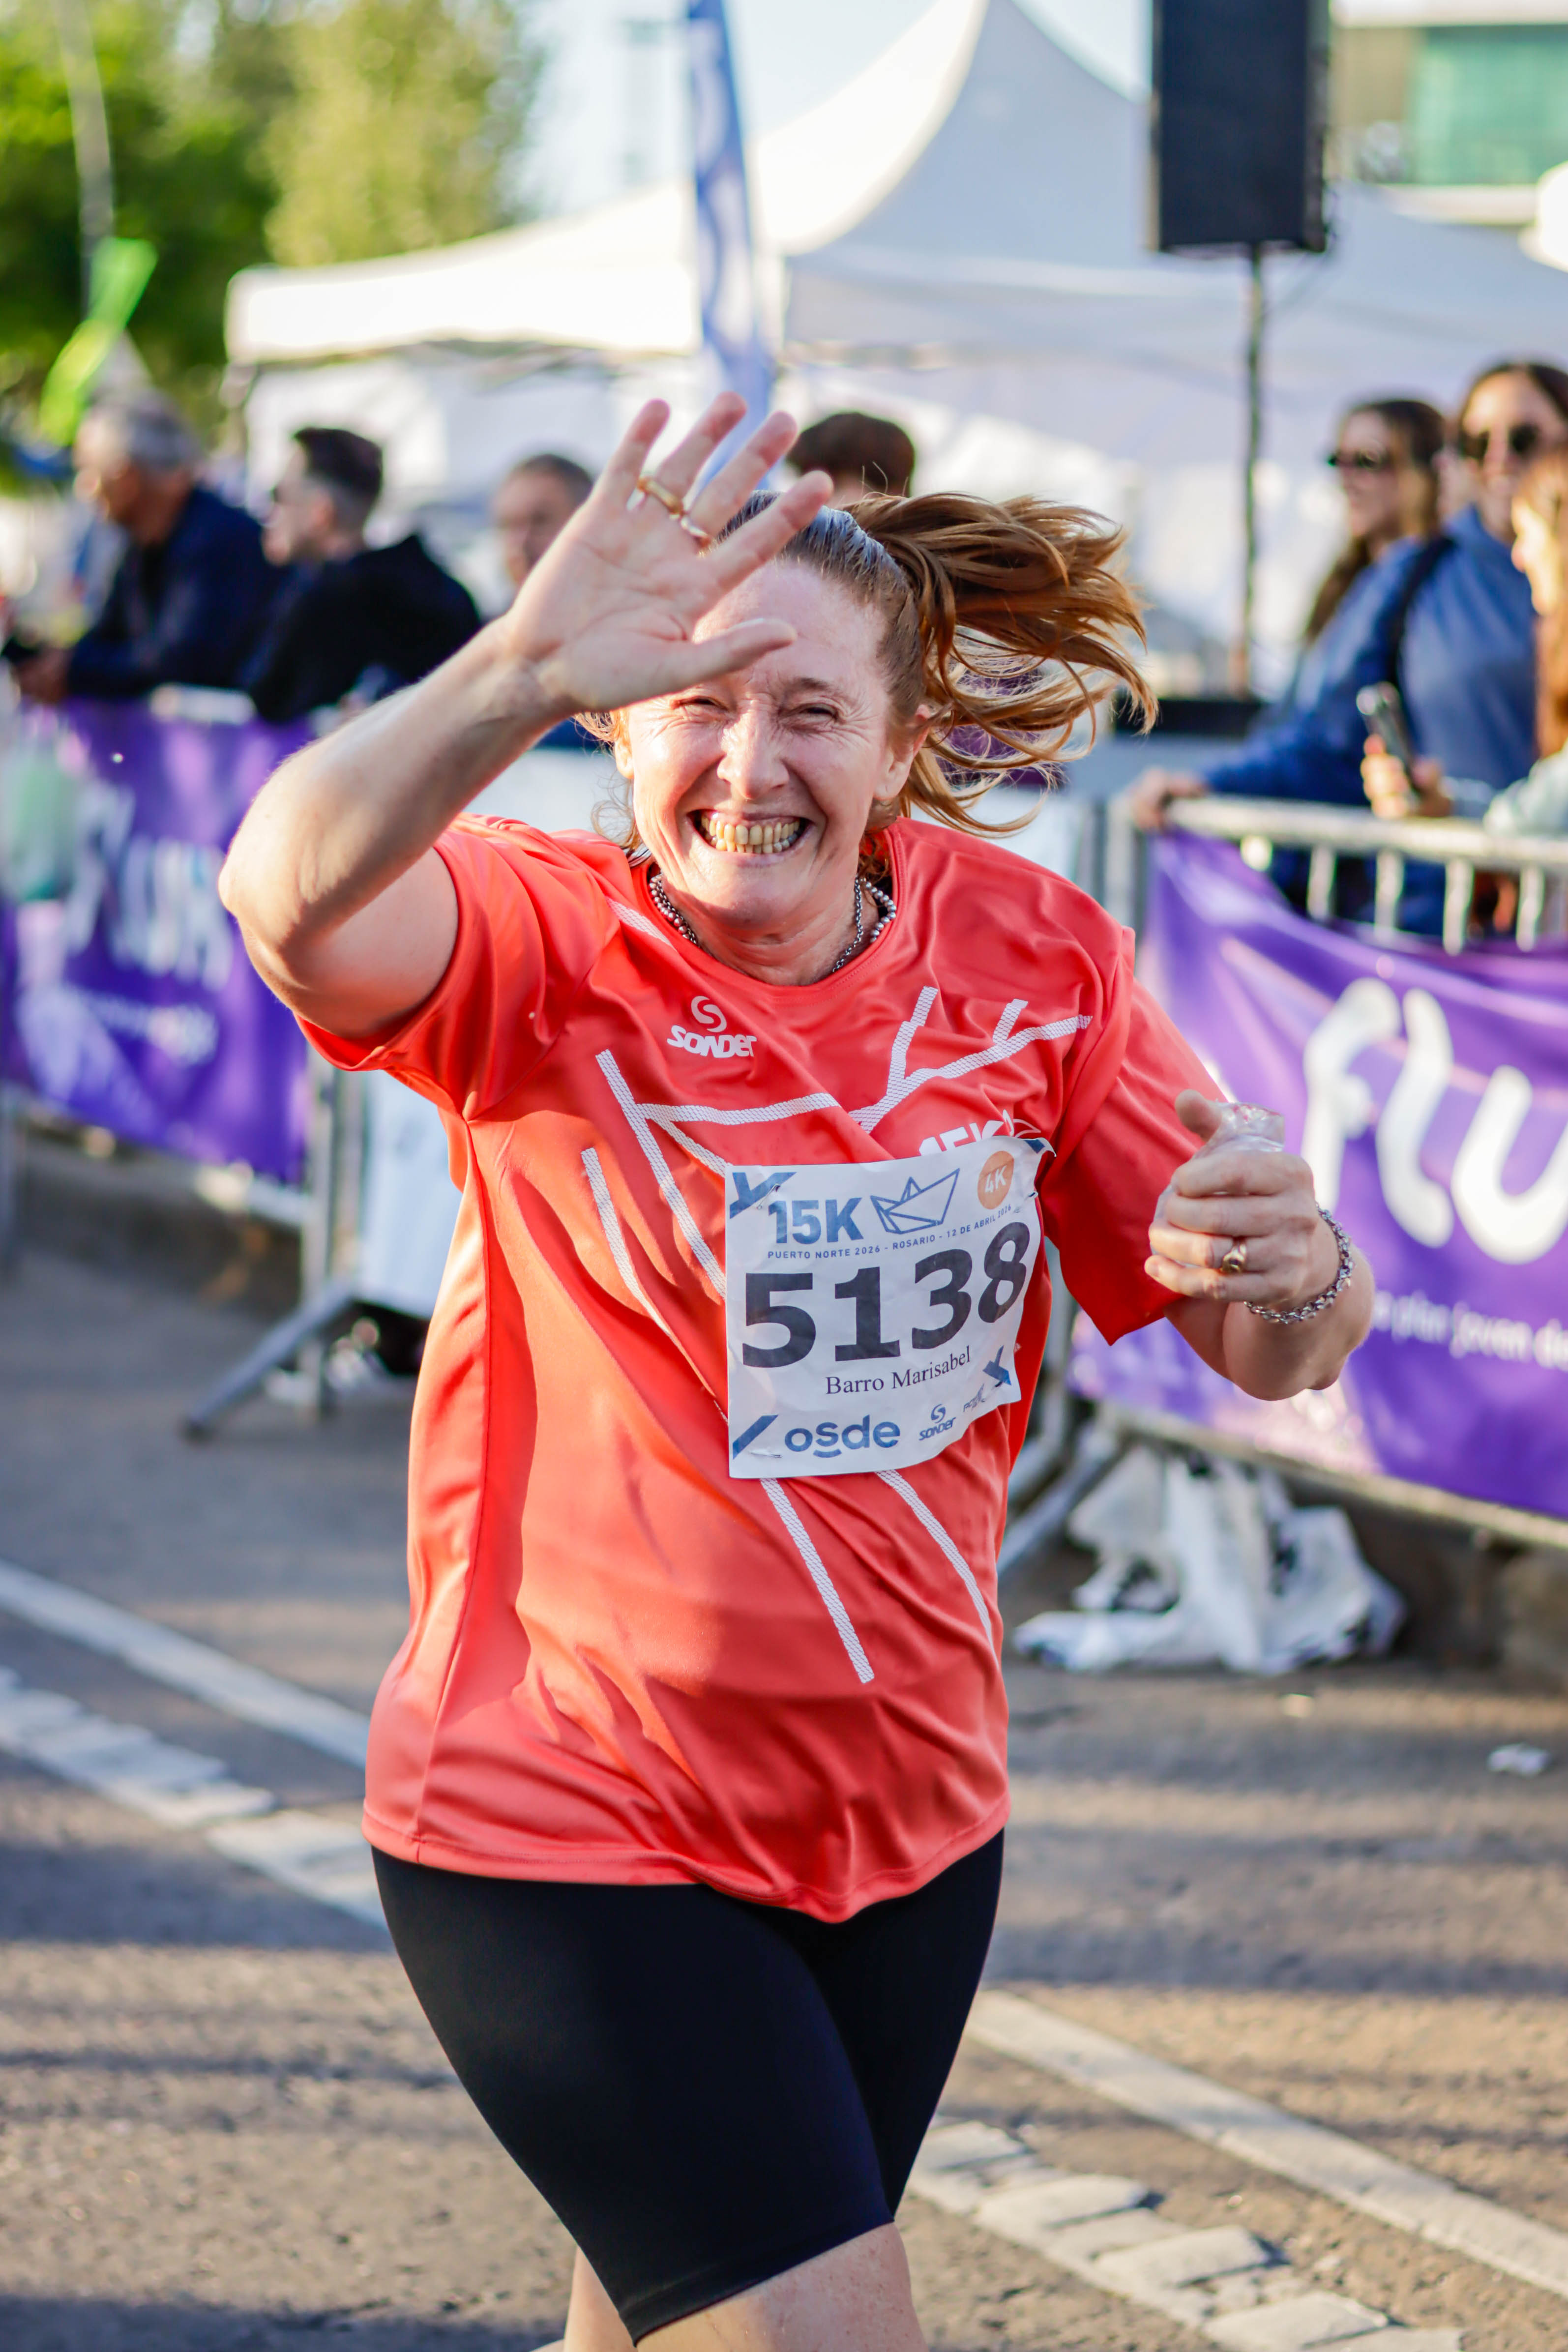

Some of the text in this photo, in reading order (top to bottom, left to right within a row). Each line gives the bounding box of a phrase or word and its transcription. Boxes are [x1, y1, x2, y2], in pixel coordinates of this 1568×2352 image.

[985, 1166, 1006, 1193] 4K
[768, 1197, 864, 1245] 15K
[815, 1249, 850, 1259] NORTE
[855, 1245, 880, 1255] 2026
[892, 1235, 935, 1250] ROSARIO
[947, 1229, 957, 1238] 12
[960, 1225, 971, 1234] DE
[974, 1216, 996, 1230] ABRIL
[998, 1205, 1011, 1218] 2026
[741, 1221, 1031, 1368] 5138
[826, 1345, 971, 1394] Barro Marisabel
[785, 1414, 900, 1458] osde
